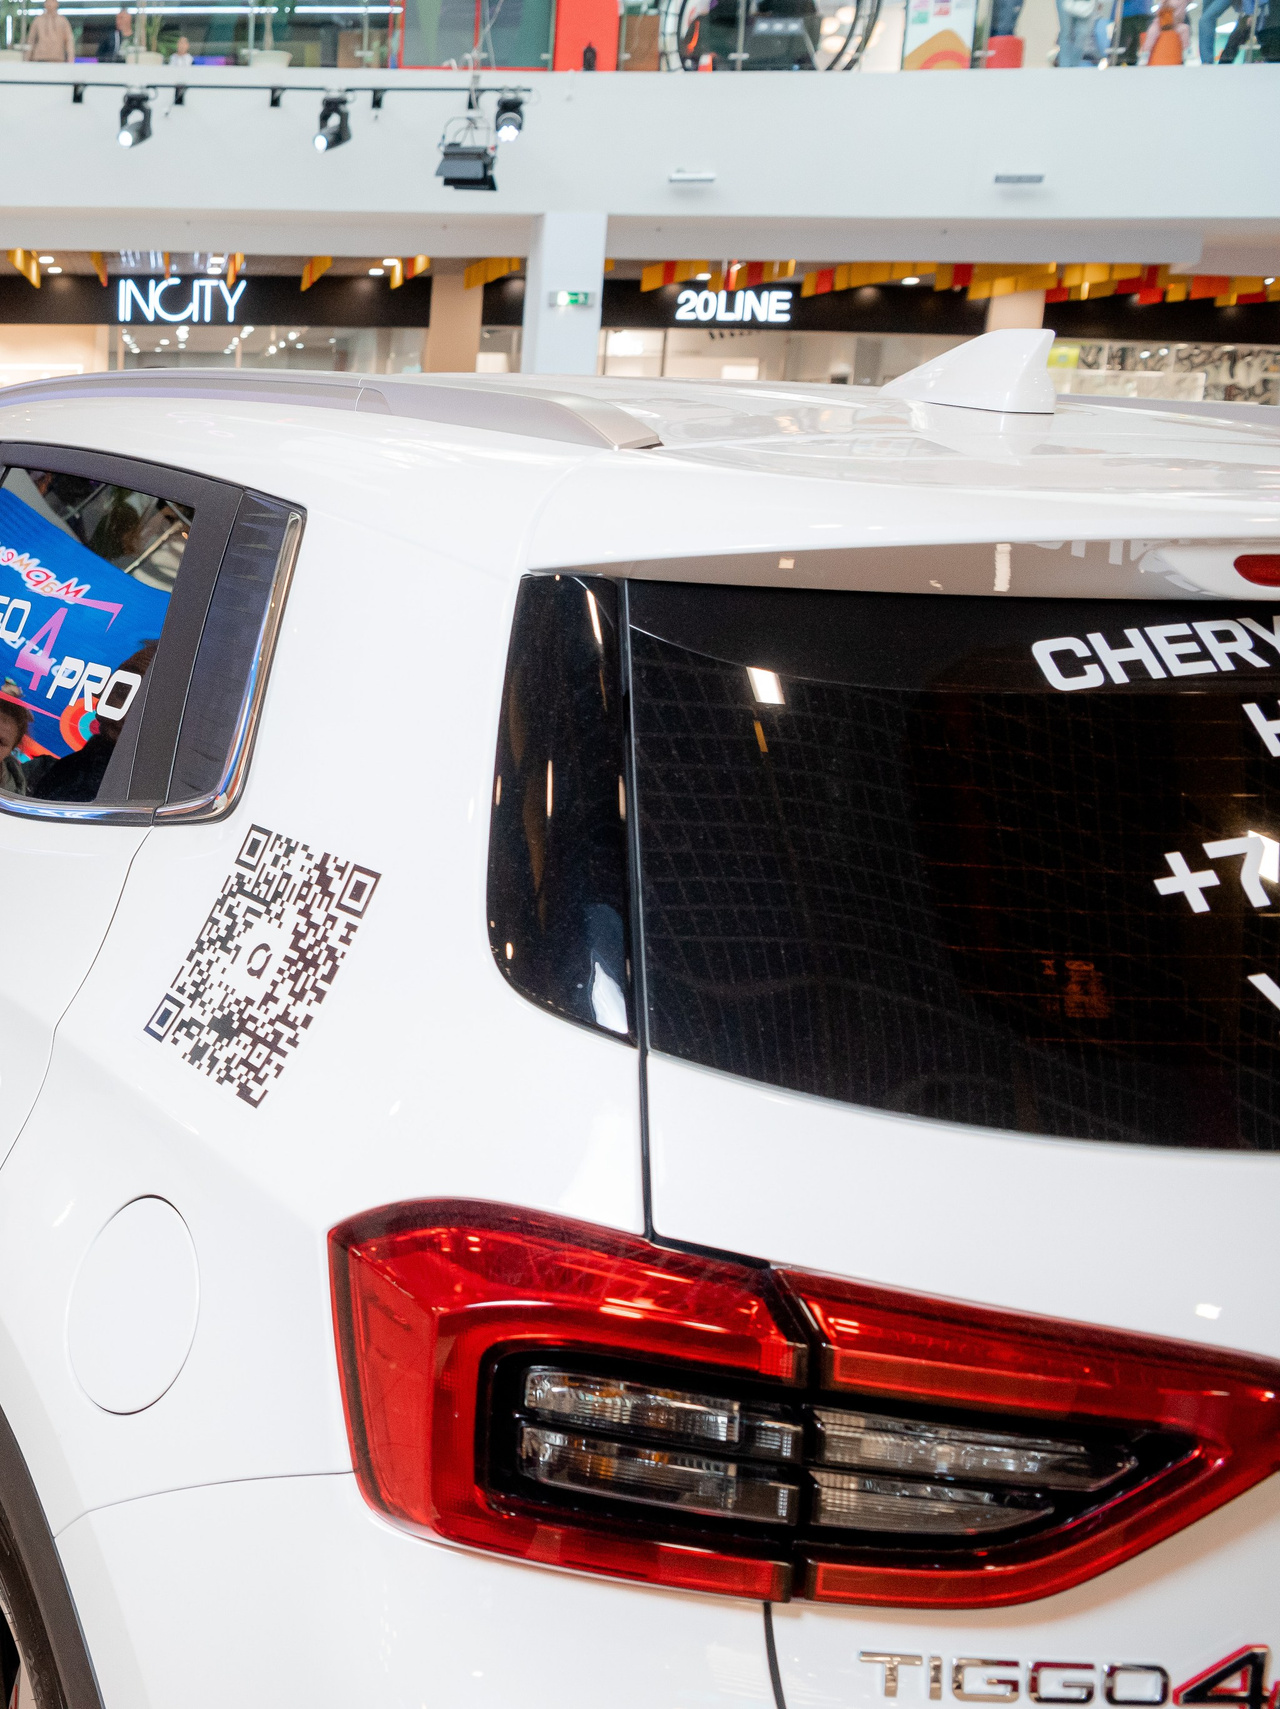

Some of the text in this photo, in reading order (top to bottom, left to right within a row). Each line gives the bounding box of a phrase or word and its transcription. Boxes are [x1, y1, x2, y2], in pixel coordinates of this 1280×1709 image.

[118, 278, 246, 323] INCITY
[675, 290, 793, 323] 20LINE
[15, 607, 68, 691] 4
[46, 656, 141, 721] PRO
